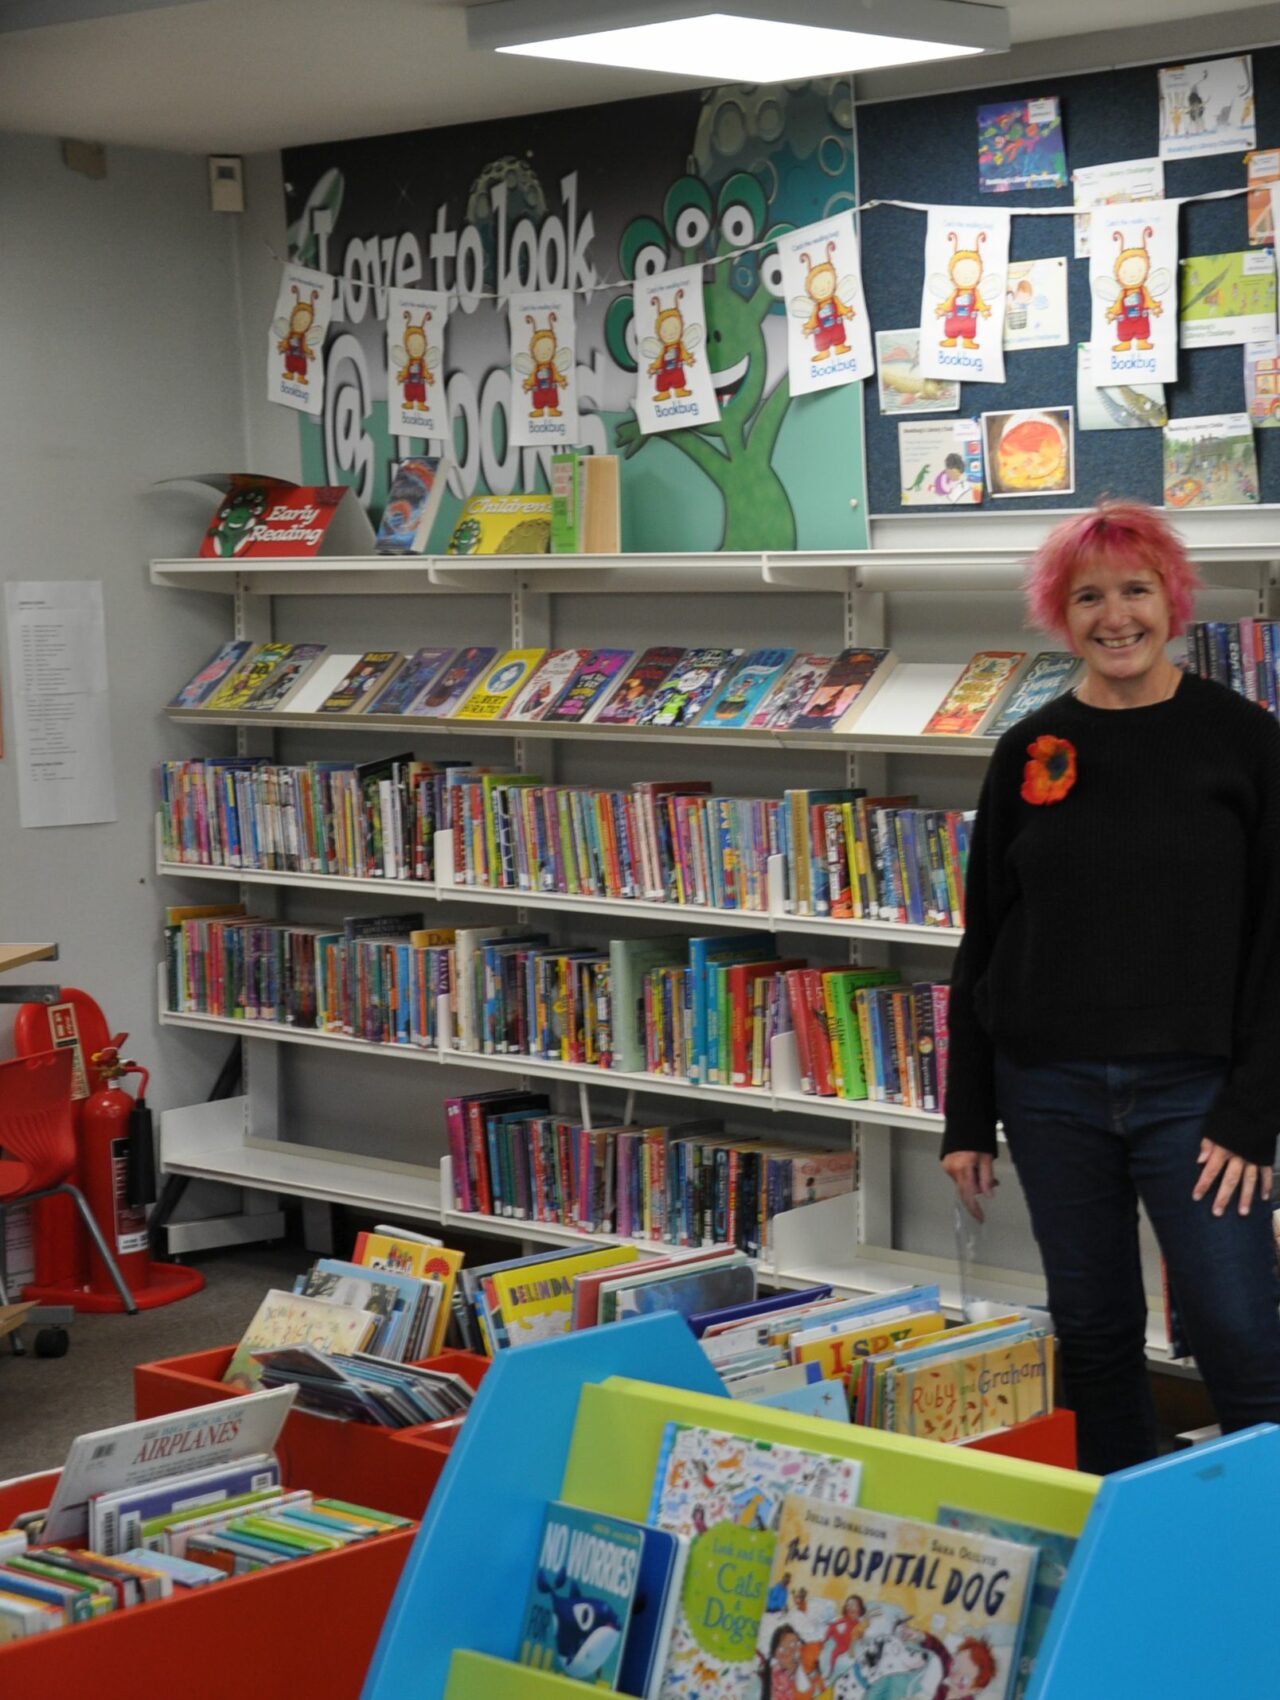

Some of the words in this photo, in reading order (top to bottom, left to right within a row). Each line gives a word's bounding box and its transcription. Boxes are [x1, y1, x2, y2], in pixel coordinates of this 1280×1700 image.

[490, 170, 597, 306] look
[429, 203, 485, 315] to
[810, 357, 858, 379] Bookbug
[938, 350, 985, 372] Bookbug
[1110, 355, 1157, 372] Bookbug
[281, 380, 311, 404] Bookbug
[401, 411, 435, 431] Bookbug
[654, 401, 700, 419] Bookbug
[528, 420, 567, 437] Bookbug
[265, 504, 321, 526] Early
[246, 523, 325, 546] Reading
[507, 1275, 573, 1308] BELINDA
[829, 1340, 847, 1375] I
[911, 1381, 958, 1415] Ruby
[977, 1360, 1047, 1395] Graham
[131, 1418, 242, 1466] AIRPLANES
[539, 1520, 570, 1574] NO
[565, 1527, 642, 1599] WORRIES
[716, 1560, 766, 1600] Cats
[811, 1541, 942, 1591] HOSPITAL
[942, 1568, 1011, 1617] DOG
[703, 1595, 761, 1645] Dogs
